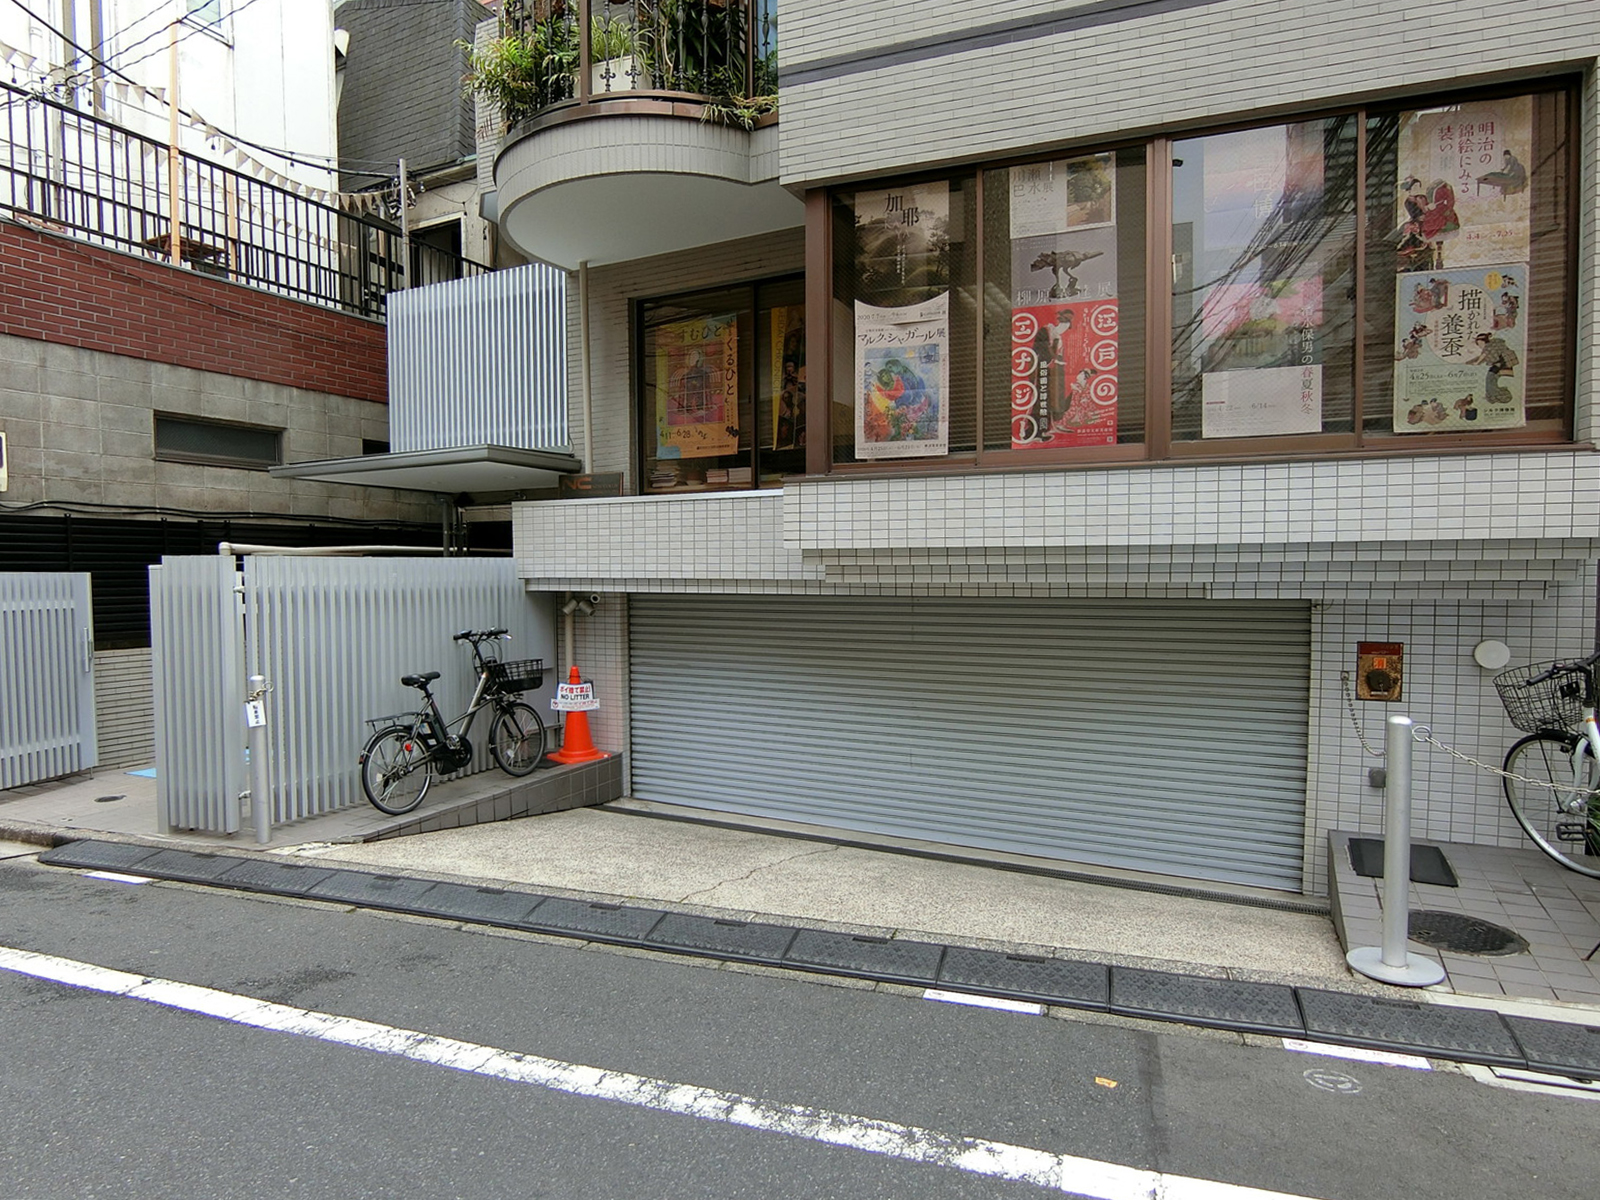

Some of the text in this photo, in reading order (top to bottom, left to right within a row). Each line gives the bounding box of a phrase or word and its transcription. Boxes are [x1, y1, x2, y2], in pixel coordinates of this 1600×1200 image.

[1437, 125, 1454, 153] 装い
[1458, 123, 1475, 194] 錦絵にみる
[1478, 121, 1495, 165] 明治の
[1013, 168, 1042, 182] 川瀬
[1013, 181, 1055, 198] 巴水展
[884, 193, 920, 227] 加耶
[1458, 288, 1483, 340] 描かれた
[680, 324, 722, 344] すむひと
[857, 327, 946, 347] マルク・シャガール展
[1440, 312, 1465, 358] 養蚕
[726, 337, 736, 395] くるひと
[1093, 309, 1117, 402] 江戸の
[1013, 316, 1035, 440] エナジー
[560, 693, 590, 701] NO LITTER
